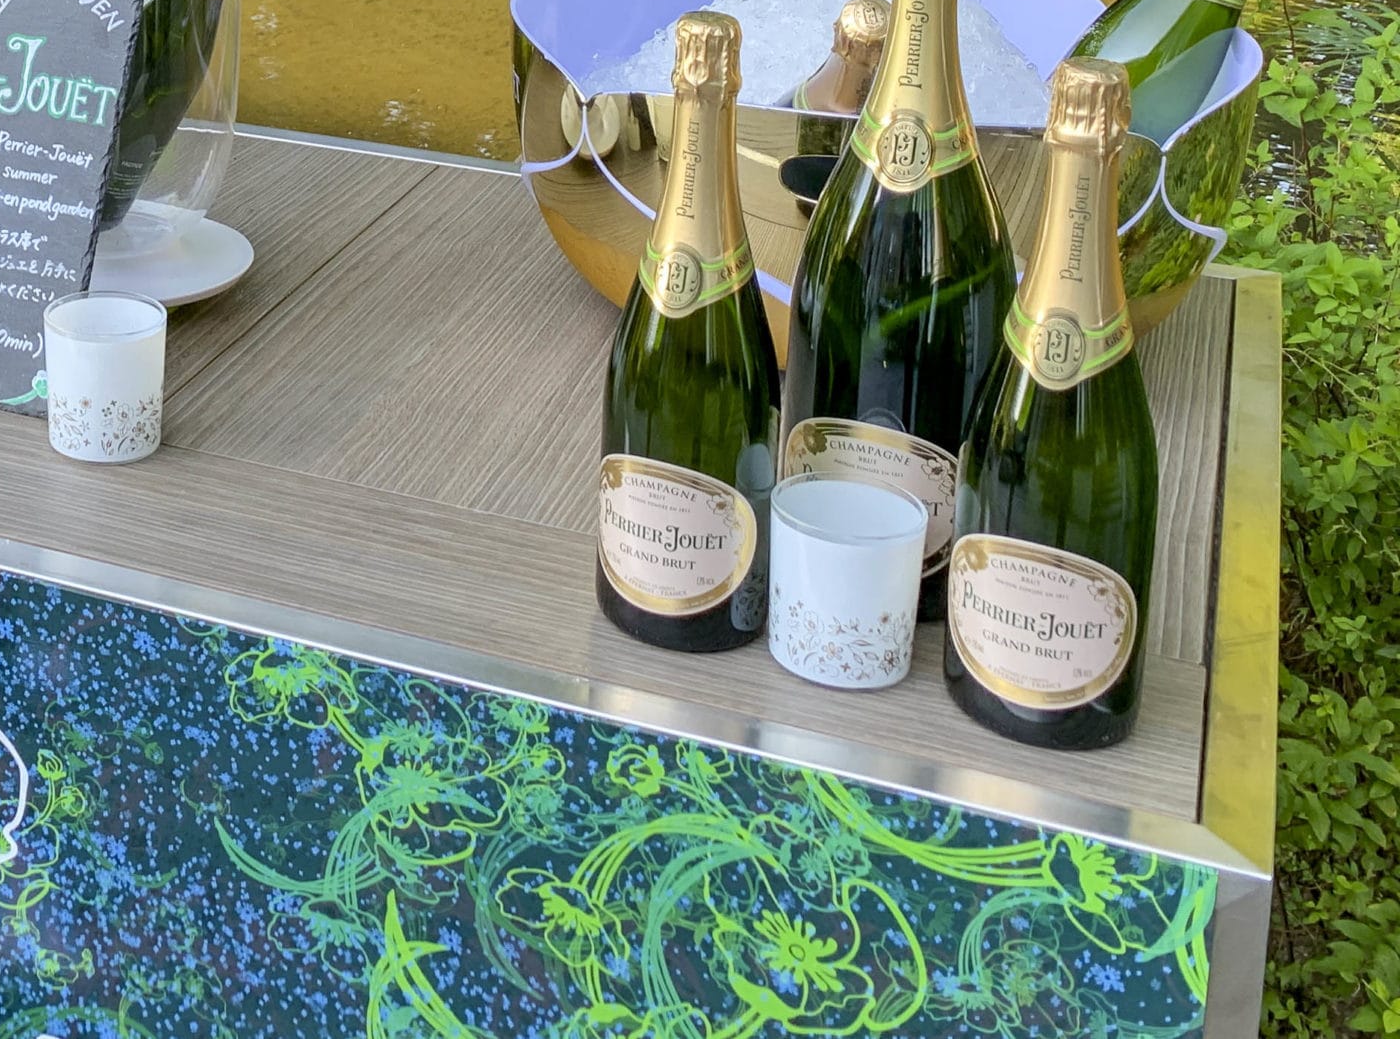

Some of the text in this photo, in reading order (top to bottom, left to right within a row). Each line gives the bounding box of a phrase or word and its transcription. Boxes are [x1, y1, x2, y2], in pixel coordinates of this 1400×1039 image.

[2, 165, 59, 186] summer
[676, 118, 702, 221] PERRIER-JOUËT
[18, 192, 53, 214] pond
[50, 199, 95, 222] garden
[1059, 175, 1092, 284] PERRIER-JOUËT
[829, 440, 912, 467] CHAMPAGNE
[623, 476, 700, 503] CHAMPAGNE
[603, 497, 728, 553] PERRIER-JOUËT
[618, 542, 660, 565] GRAND
[662, 557, 697, 572] BRUT
[989, 558, 1079, 588] CHAMPAGNE
[961, 579, 1109, 642] PERRIER-JOUËT
[981, 627, 1031, 654] GRAND
[1034, 644, 1074, 662] BRUT
